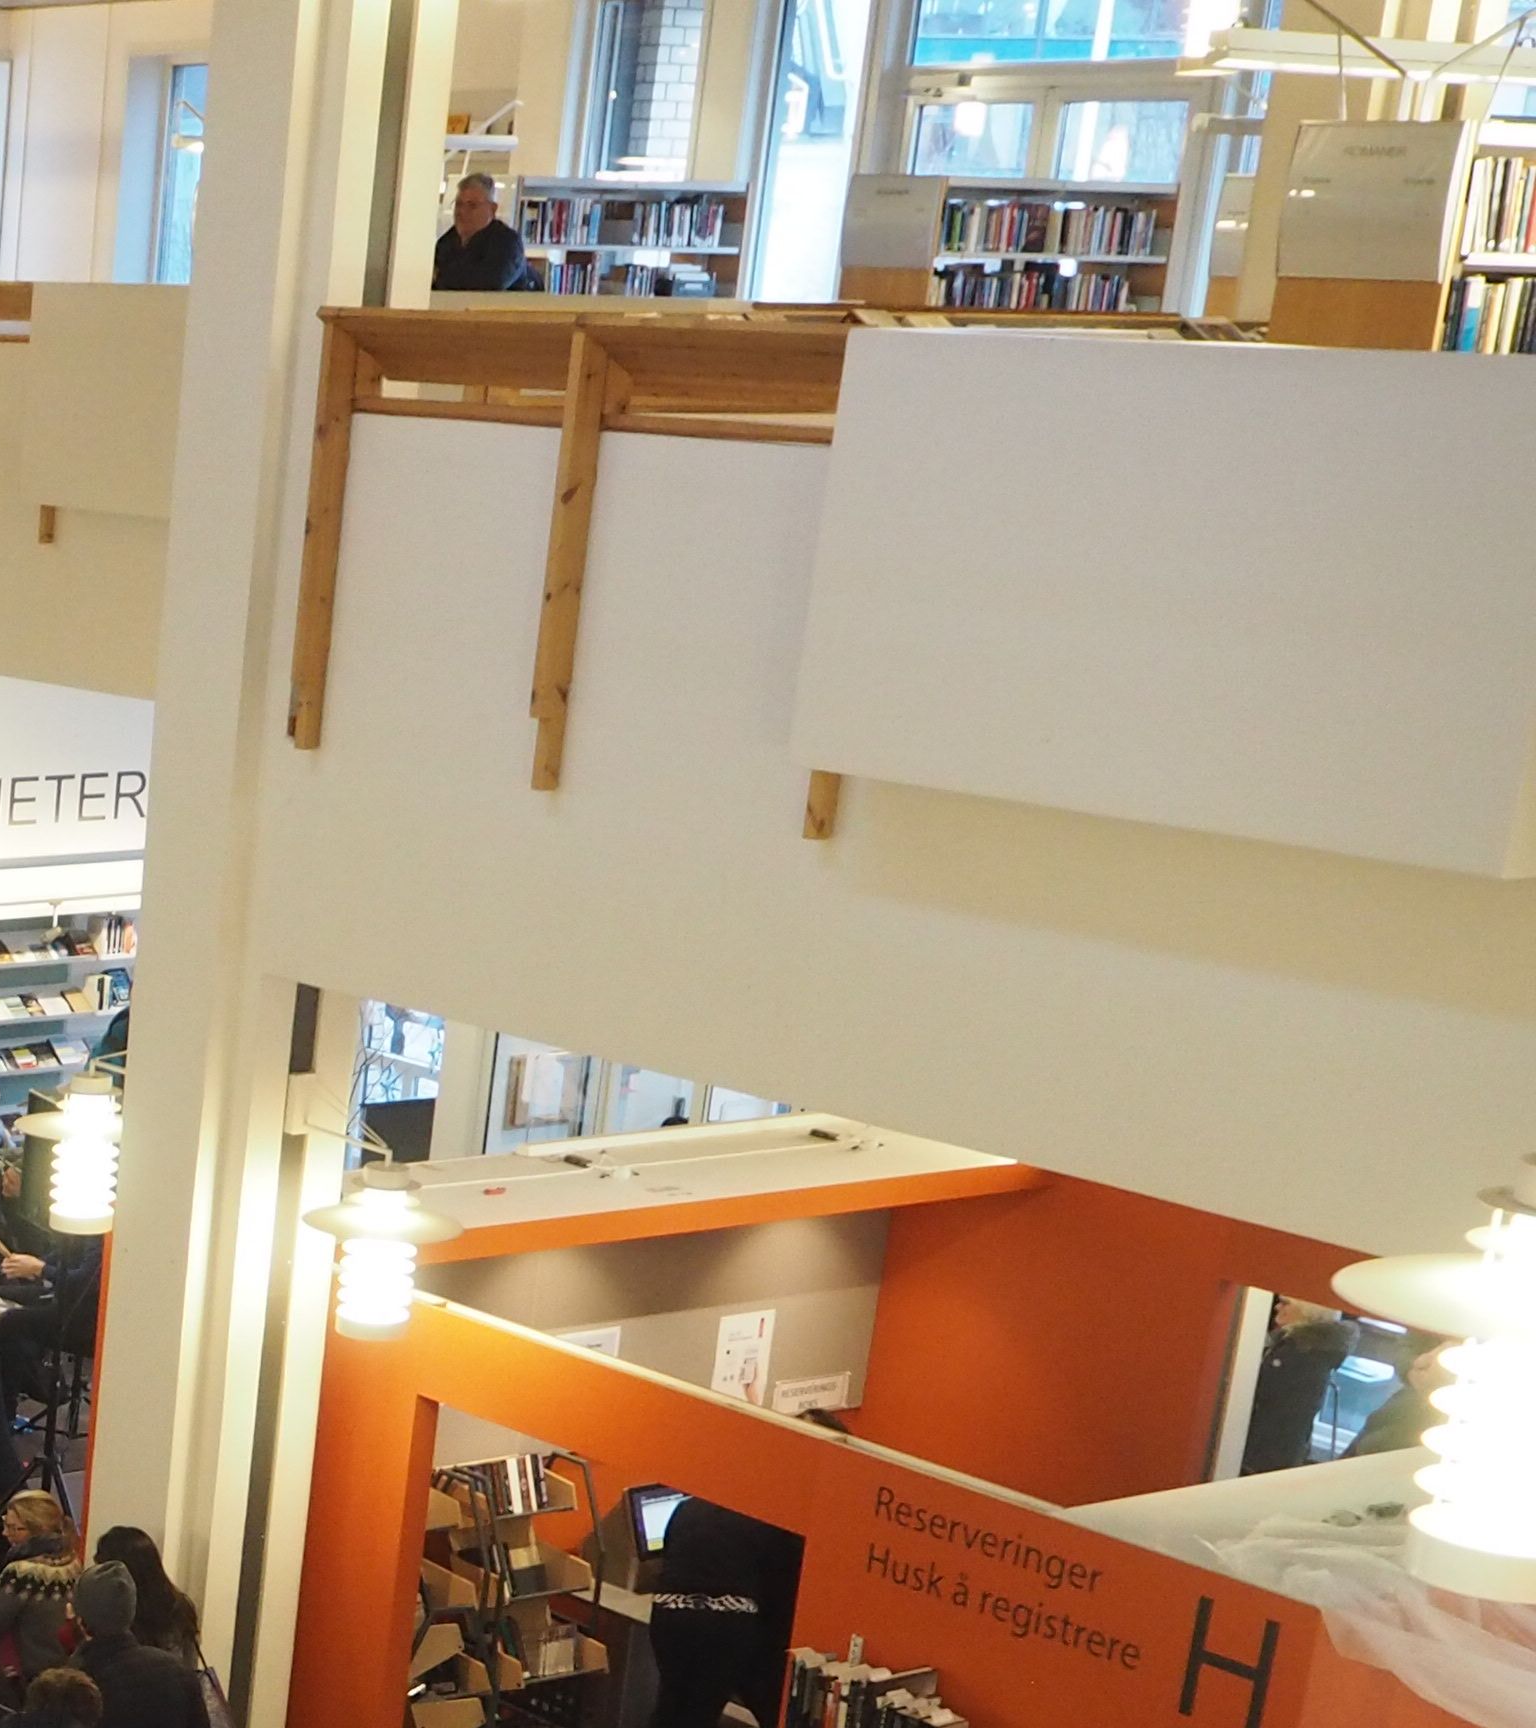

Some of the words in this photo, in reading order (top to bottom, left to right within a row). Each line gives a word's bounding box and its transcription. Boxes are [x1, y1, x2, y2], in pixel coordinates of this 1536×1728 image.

[874, 1486, 1104, 1594] Reserveringer
[866, 1543, 943, 1603] Husk
[951, 1573, 969, 1606] å
[979, 1593, 1142, 1670] registrere
